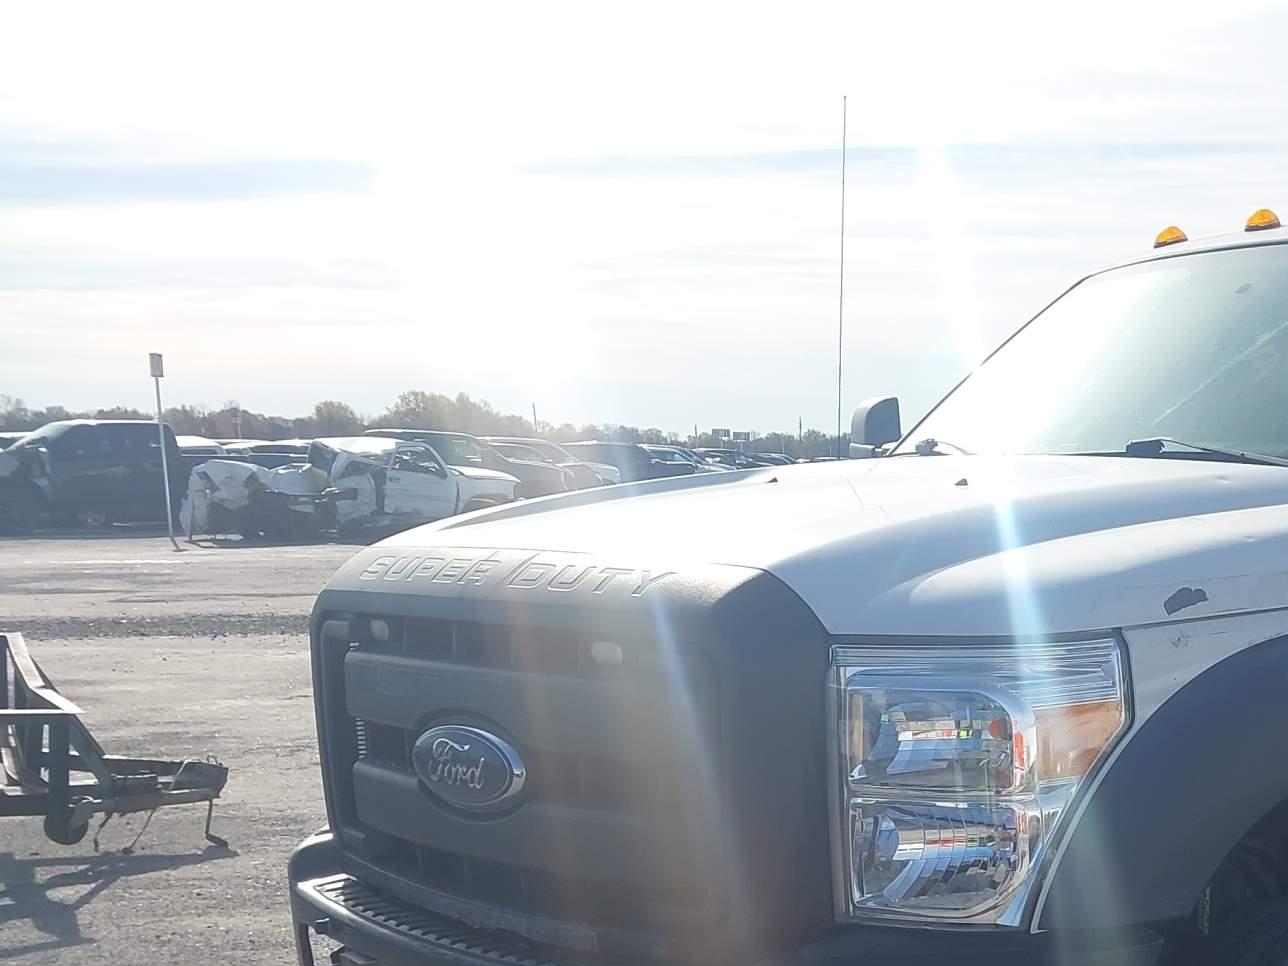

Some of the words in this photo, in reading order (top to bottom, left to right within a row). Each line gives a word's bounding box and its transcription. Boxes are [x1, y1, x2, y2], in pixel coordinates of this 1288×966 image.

[358, 554, 502, 586] SUPER
[506, 561, 678, 598] DUTY
[428, 737, 486, 790] Ford
